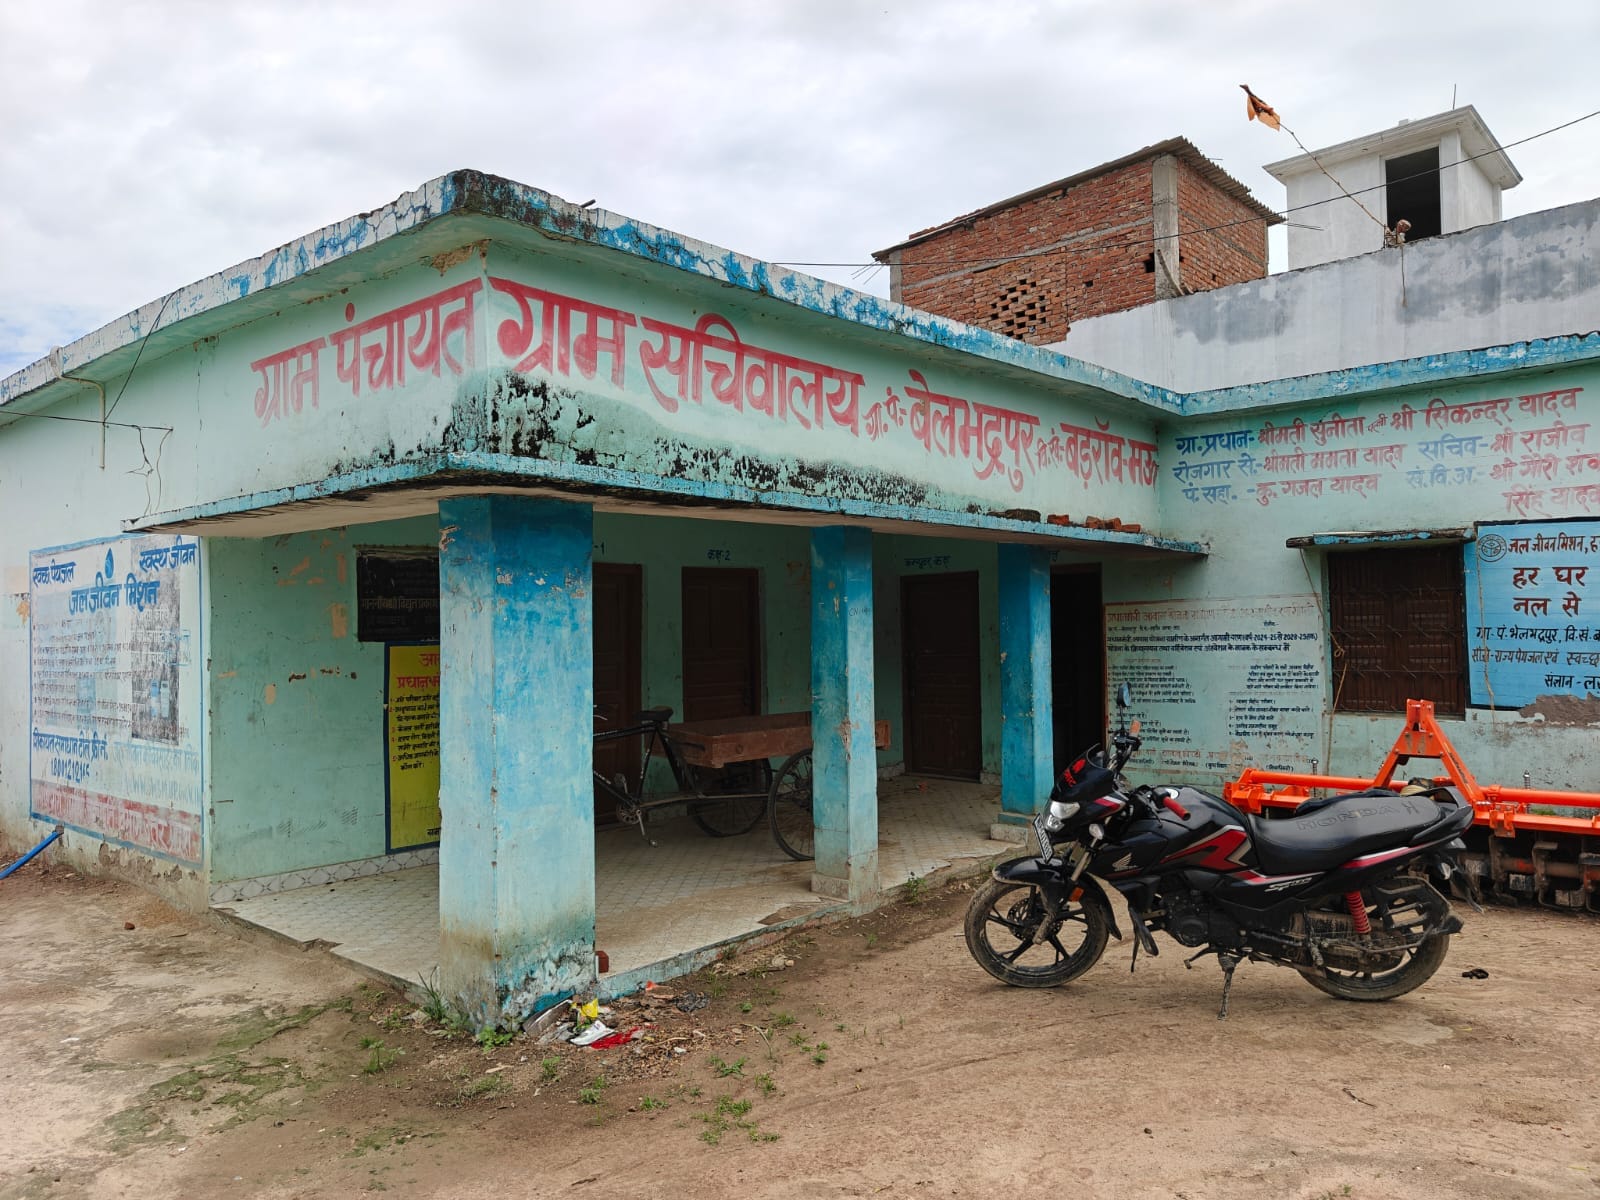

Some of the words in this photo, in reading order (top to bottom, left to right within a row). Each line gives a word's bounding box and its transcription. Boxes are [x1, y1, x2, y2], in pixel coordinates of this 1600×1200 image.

[250, 336, 327, 428] ग्राम
[329, 278, 483, 398] पंचायत
[489, 276, 638, 390] ग्राम
[640, 313, 865, 437] सचिवालय
[1258, 417, 1307, 446] श्रीमती
[1309, 412, 1366, 446] सुनीता
[1390, 403, 1418, 431] श्री
[1516, 387, 1584, 418] यादव
[1361, 444, 1408, 470] यादव
[1508, 538, 1532, 554] जल
[1532, 533, 1557, 552] जीवन
[1512, 567, 1540, 589] हर
[1552, 566, 1588, 587] घर
[88, 571, 122, 614] जीवन
[124, 572, 160, 612] मिशन
[1513, 597, 1552, 617] नल
[1562, 591, 1583, 617] से
[1297, 805, 1397, 831] HONDA
